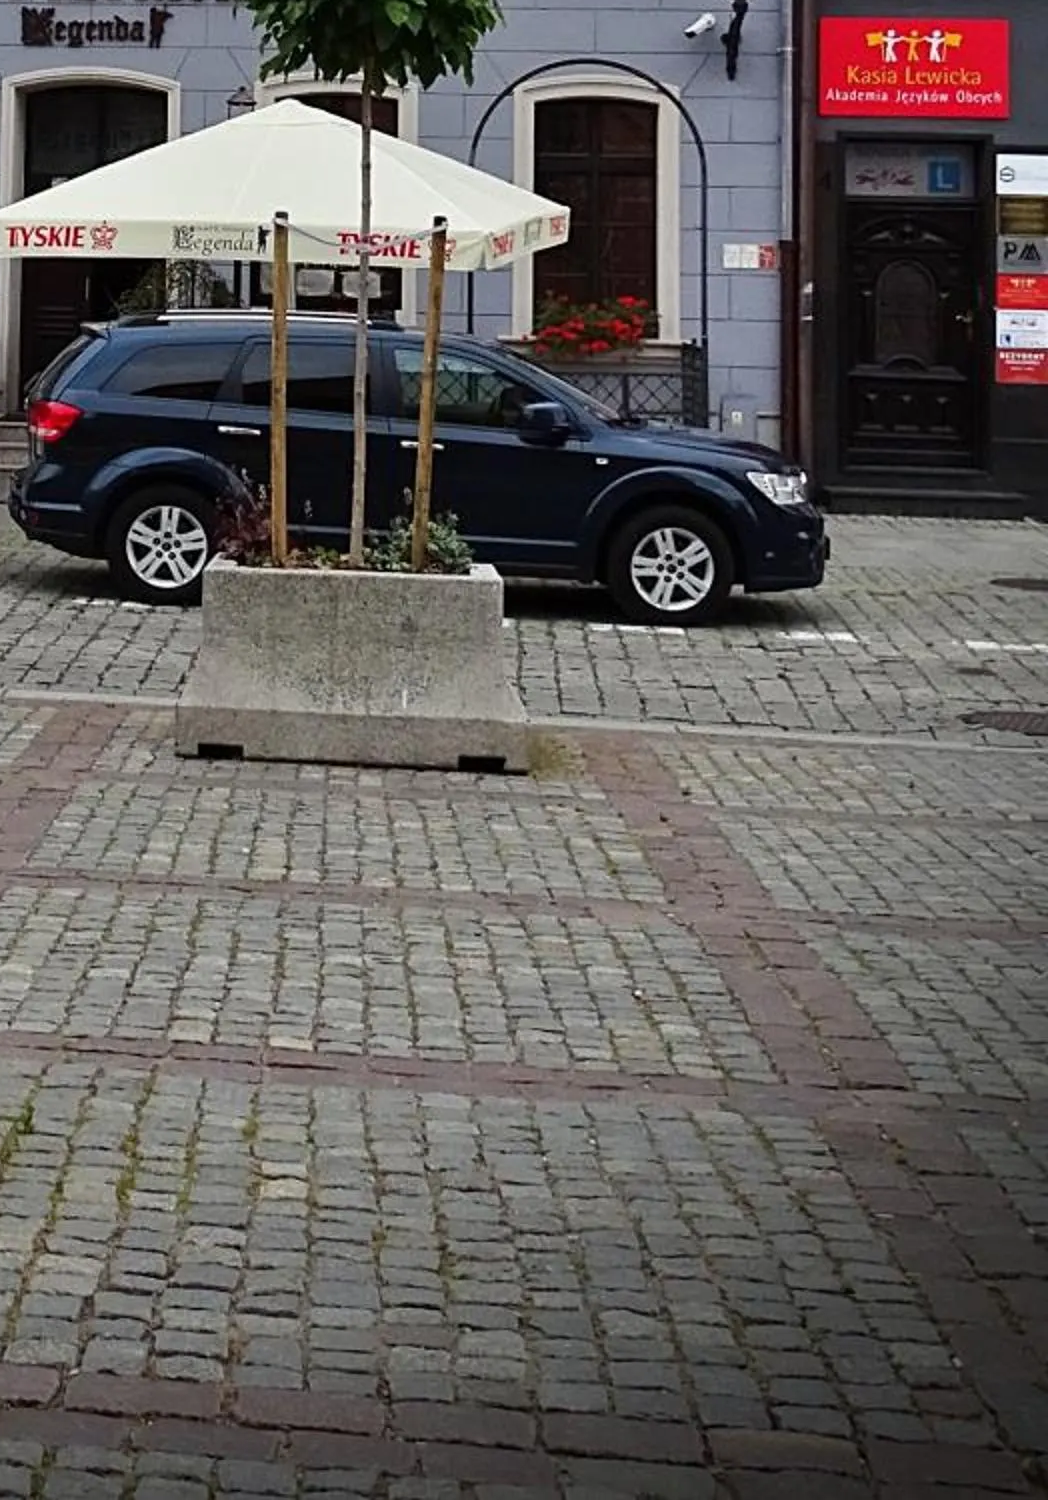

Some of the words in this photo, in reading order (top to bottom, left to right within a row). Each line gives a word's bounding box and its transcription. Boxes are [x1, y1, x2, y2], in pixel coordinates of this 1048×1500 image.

[847, 66, 897, 84] Kasia
[905, 67, 982, 85] Lewicka
[826, 88, 888, 102] Akademia
[956, 90, 1002, 105] Obcych
[5, 226, 86, 248] TYSKIE
